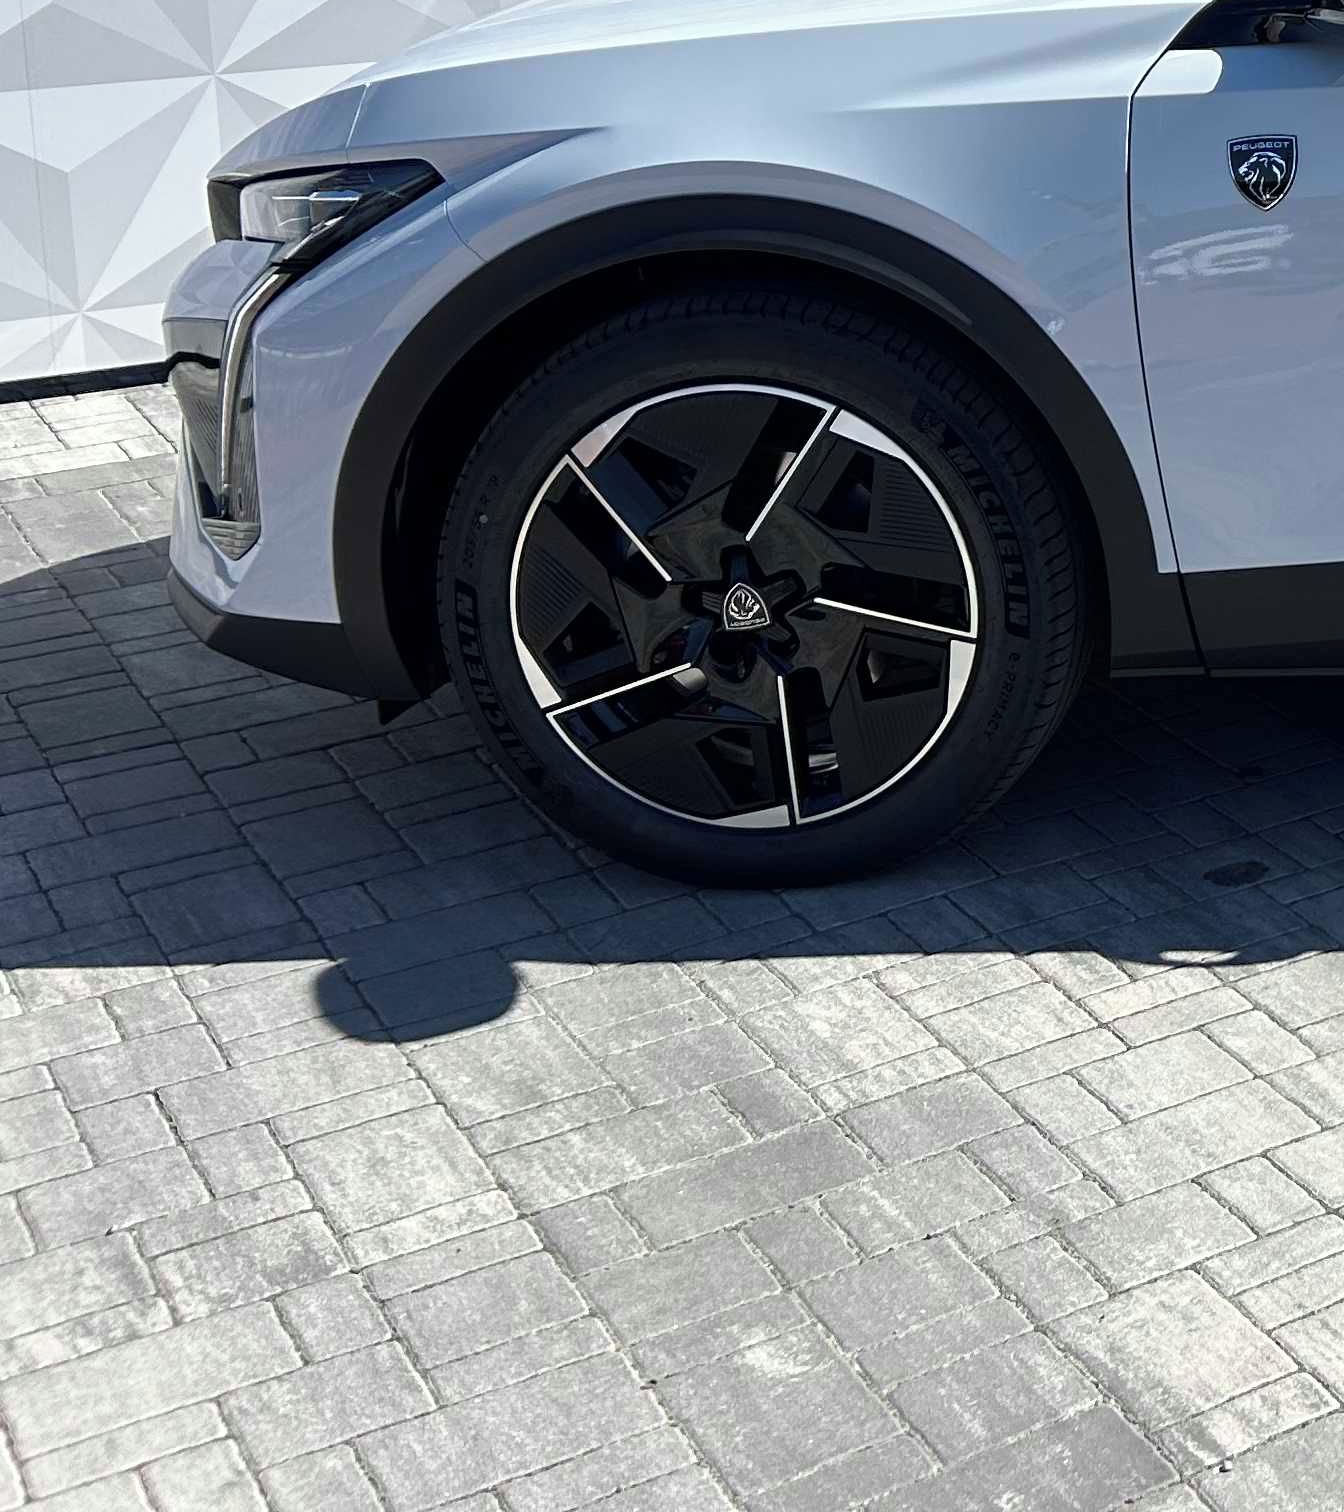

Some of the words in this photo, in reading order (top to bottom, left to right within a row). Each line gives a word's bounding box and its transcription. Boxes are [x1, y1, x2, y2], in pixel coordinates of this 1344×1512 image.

[1232, 142, 1290, 151] PEUGEOT
[946, 441, 1028, 625] MICHELIN
[456, 593, 539, 774] MICHELIN
